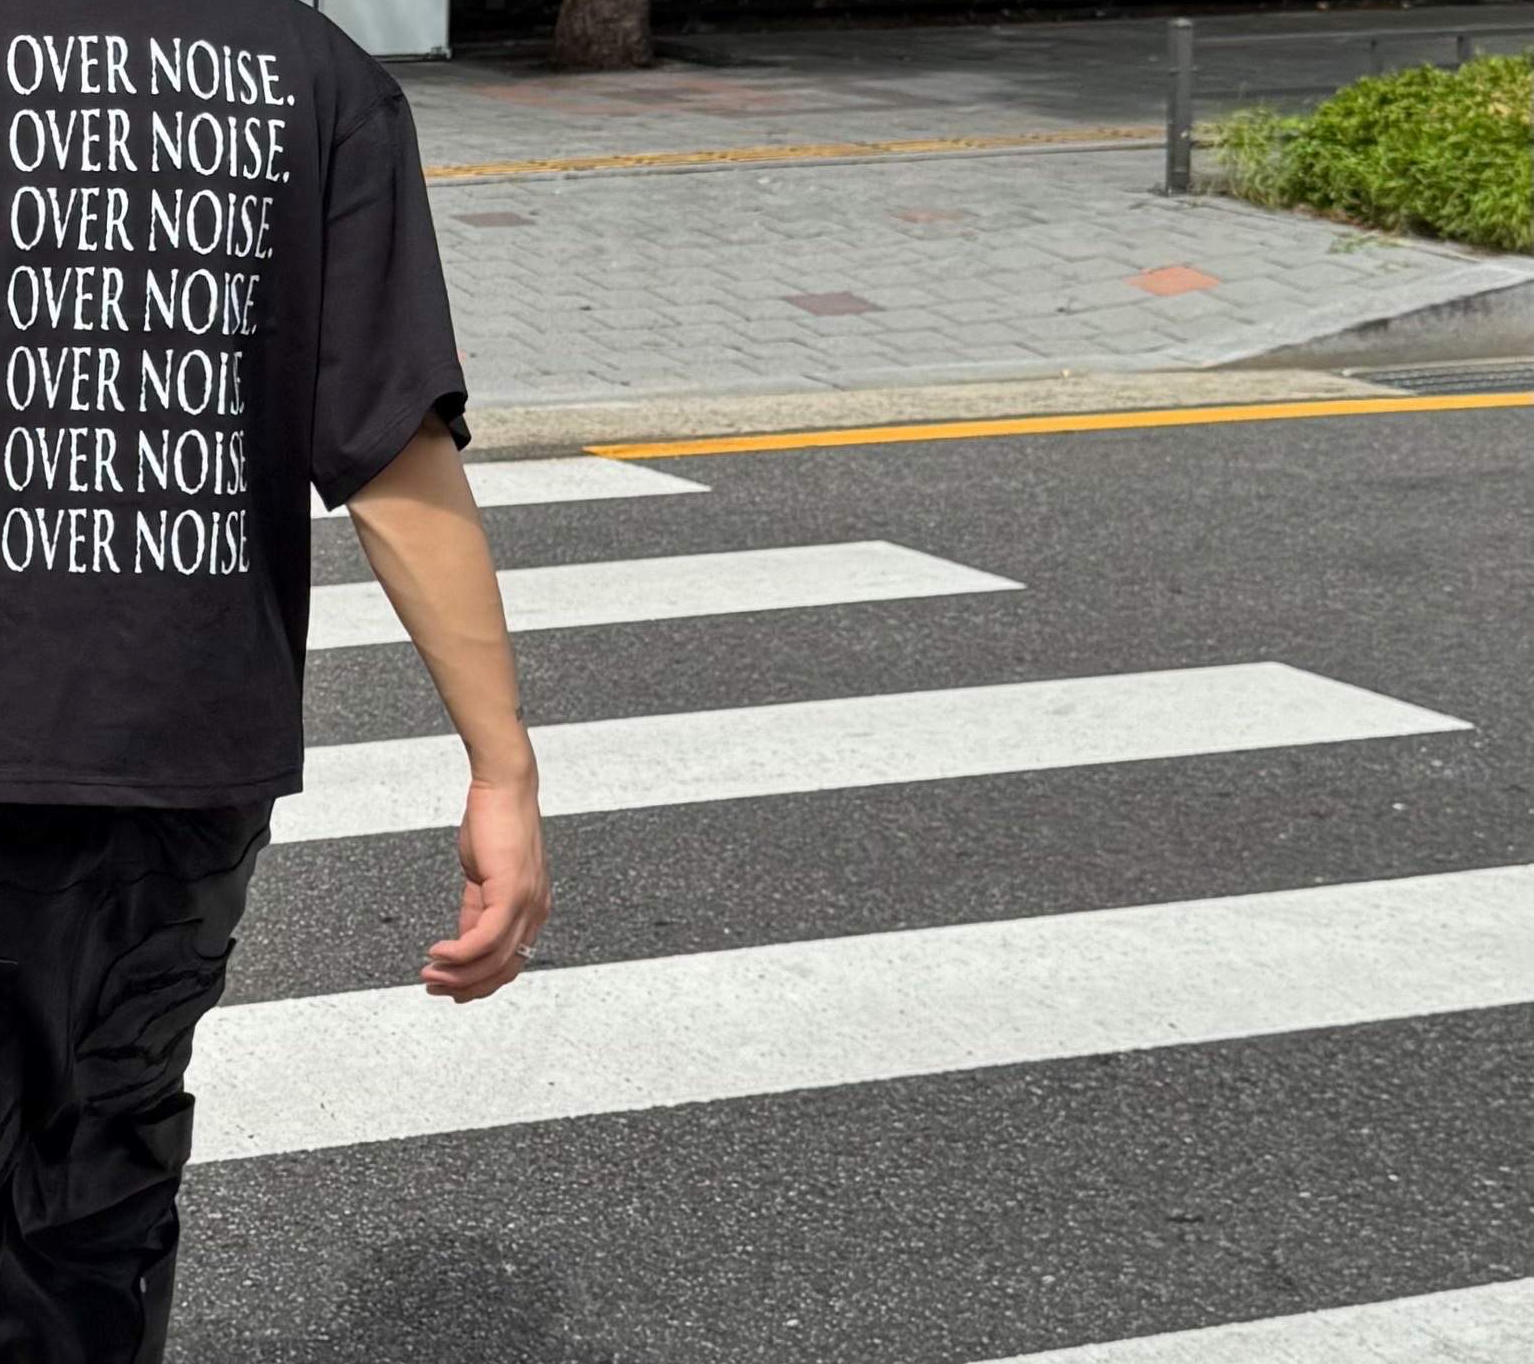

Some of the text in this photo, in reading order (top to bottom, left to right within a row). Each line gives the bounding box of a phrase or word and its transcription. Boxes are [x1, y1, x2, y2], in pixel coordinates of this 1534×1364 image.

[6, 34, 138, 96] OVER
[149, 37, 295, 106] NOISE.
[8, 107, 138, 173] OVER
[151, 110, 290, 183] NOISE.
[10, 185, 135, 252] OVER
[7, 265, 129, 332] OVER
[6, 345, 126, 412] OVER
[4, 426, 124, 493] OVER
[1, 507, 121, 574] OVER
